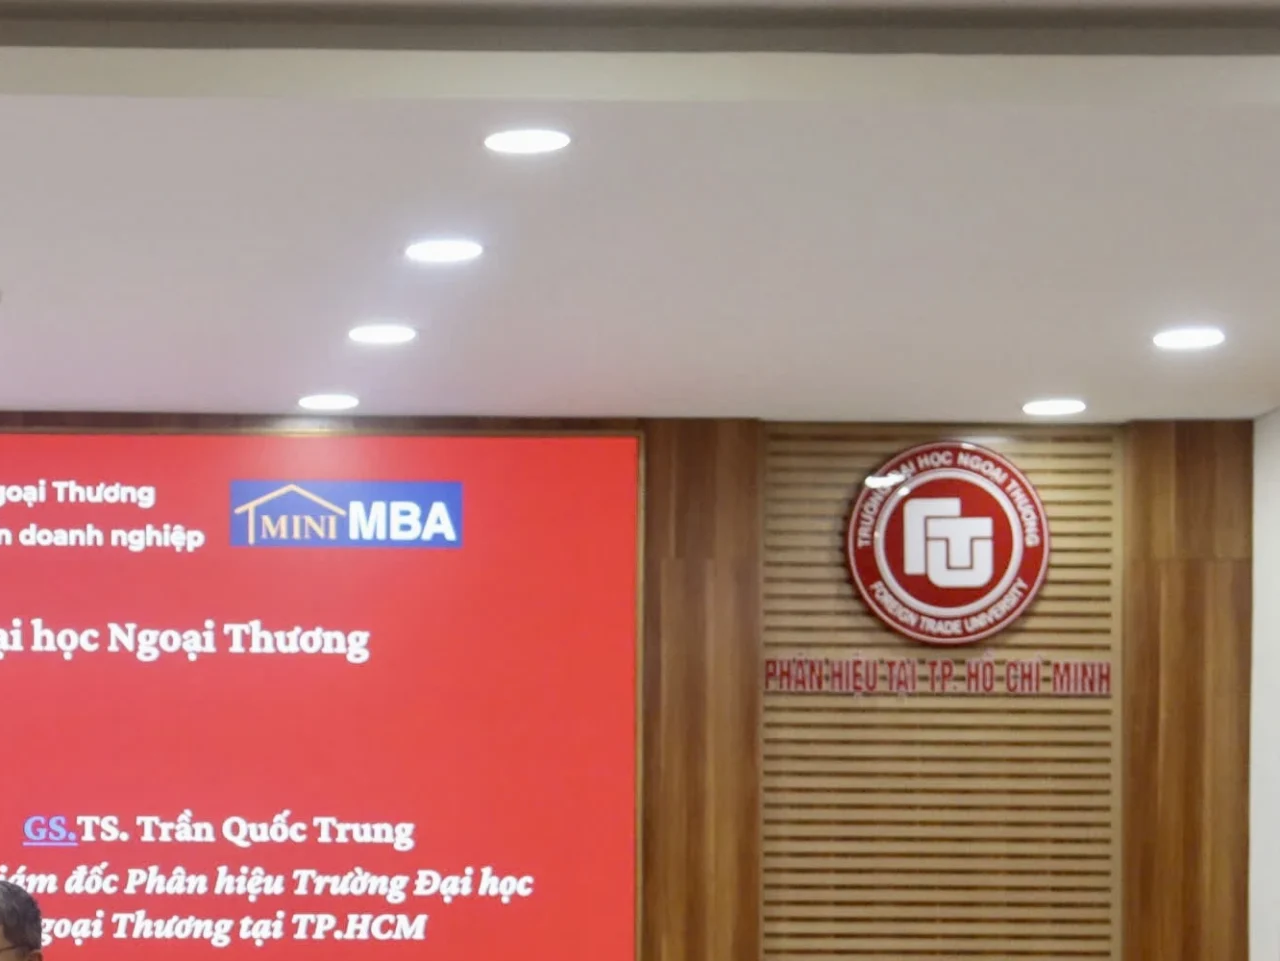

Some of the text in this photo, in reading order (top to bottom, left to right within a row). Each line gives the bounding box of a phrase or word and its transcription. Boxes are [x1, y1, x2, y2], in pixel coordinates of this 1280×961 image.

[51, 480, 156, 509] Thương
[18, 522, 105, 547] doanh
[110, 523, 206, 553] nghiệp
[260, 514, 339, 541] MINI
[347, 499, 458, 543] MBA
[30, 618, 100, 661] học
[107, 618, 217, 663] Ngoại
[222, 618, 371, 664] Thương
[919, 615, 964, 636] TRADE
[1051, 660, 1112, 694] MINH
[135, 808, 217, 843] Trần
[221, 809, 308, 848] Quốc
[312, 816, 415, 852] Trung
[63, 861, 120, 895] đốc
[123, 864, 209, 895] Phân
[213, 864, 285, 903] hiệu
[292, 866, 410, 904] Trường
[413, 866, 474, 904] Đại
[477, 865, 534, 904] học
[40, 909, 429, 948] goại Thương tại TP.HCM
